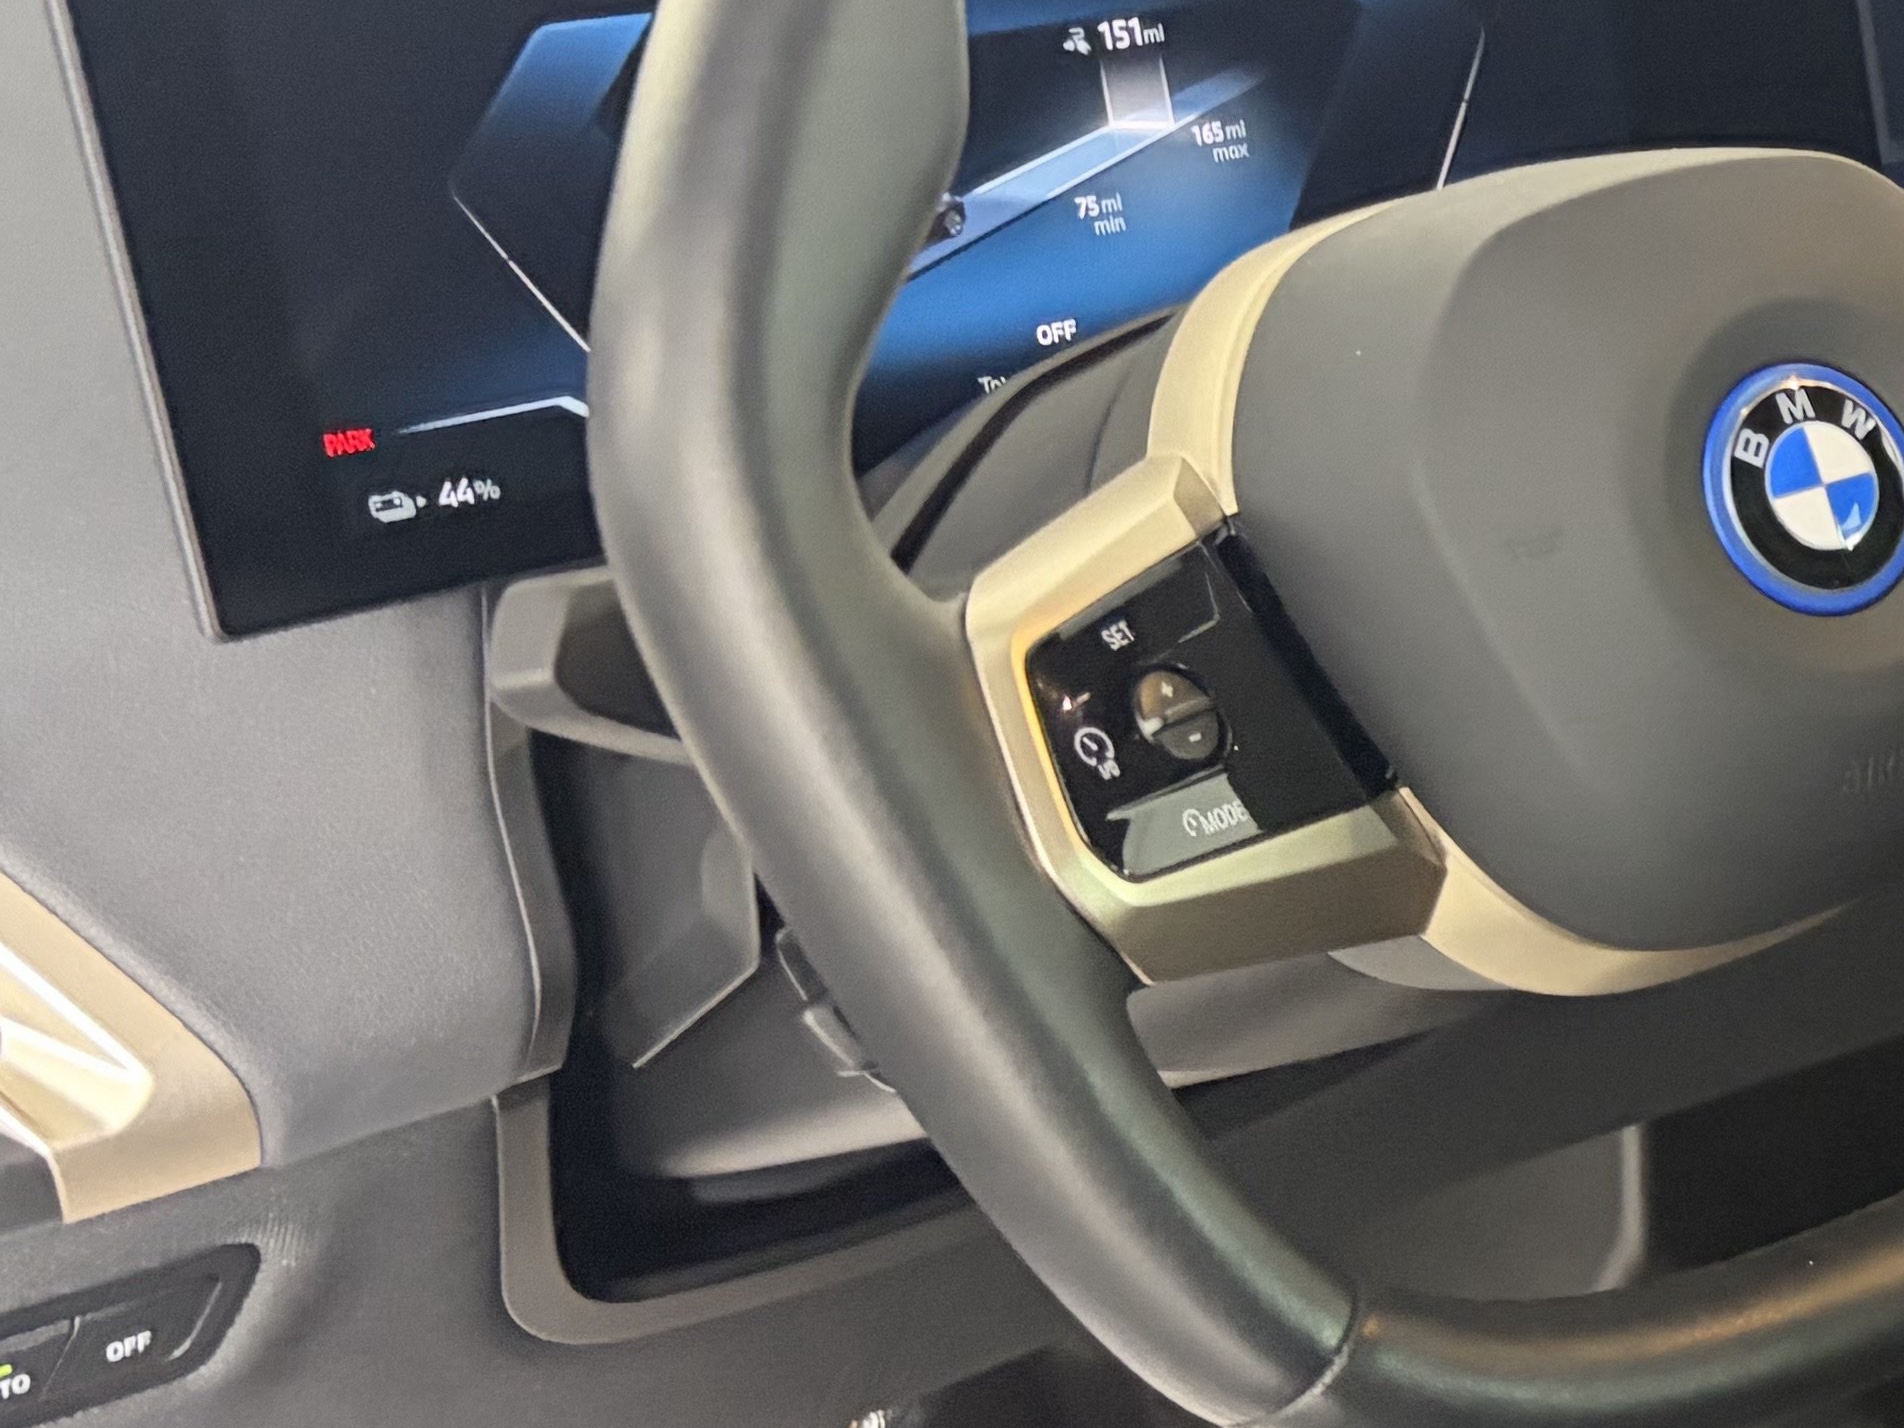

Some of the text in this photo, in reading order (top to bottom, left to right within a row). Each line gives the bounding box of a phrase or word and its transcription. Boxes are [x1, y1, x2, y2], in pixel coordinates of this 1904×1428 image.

[1190, 120, 1226, 147] 165
[1212, 142, 1250, 163] max
[1074, 194, 1100, 220] 75
[1094, 215, 1127, 236] min
[1036, 318, 1077, 346] OFF
[323, 428, 376, 458] PARK
[1734, 388, 1877, 469] BMW
[438, 476, 501, 508] 44%
[1100, 620, 1135, 652] SET
[1202, 800, 1249, 837] MODE
[106, 1330, 152, 1362] OFF
